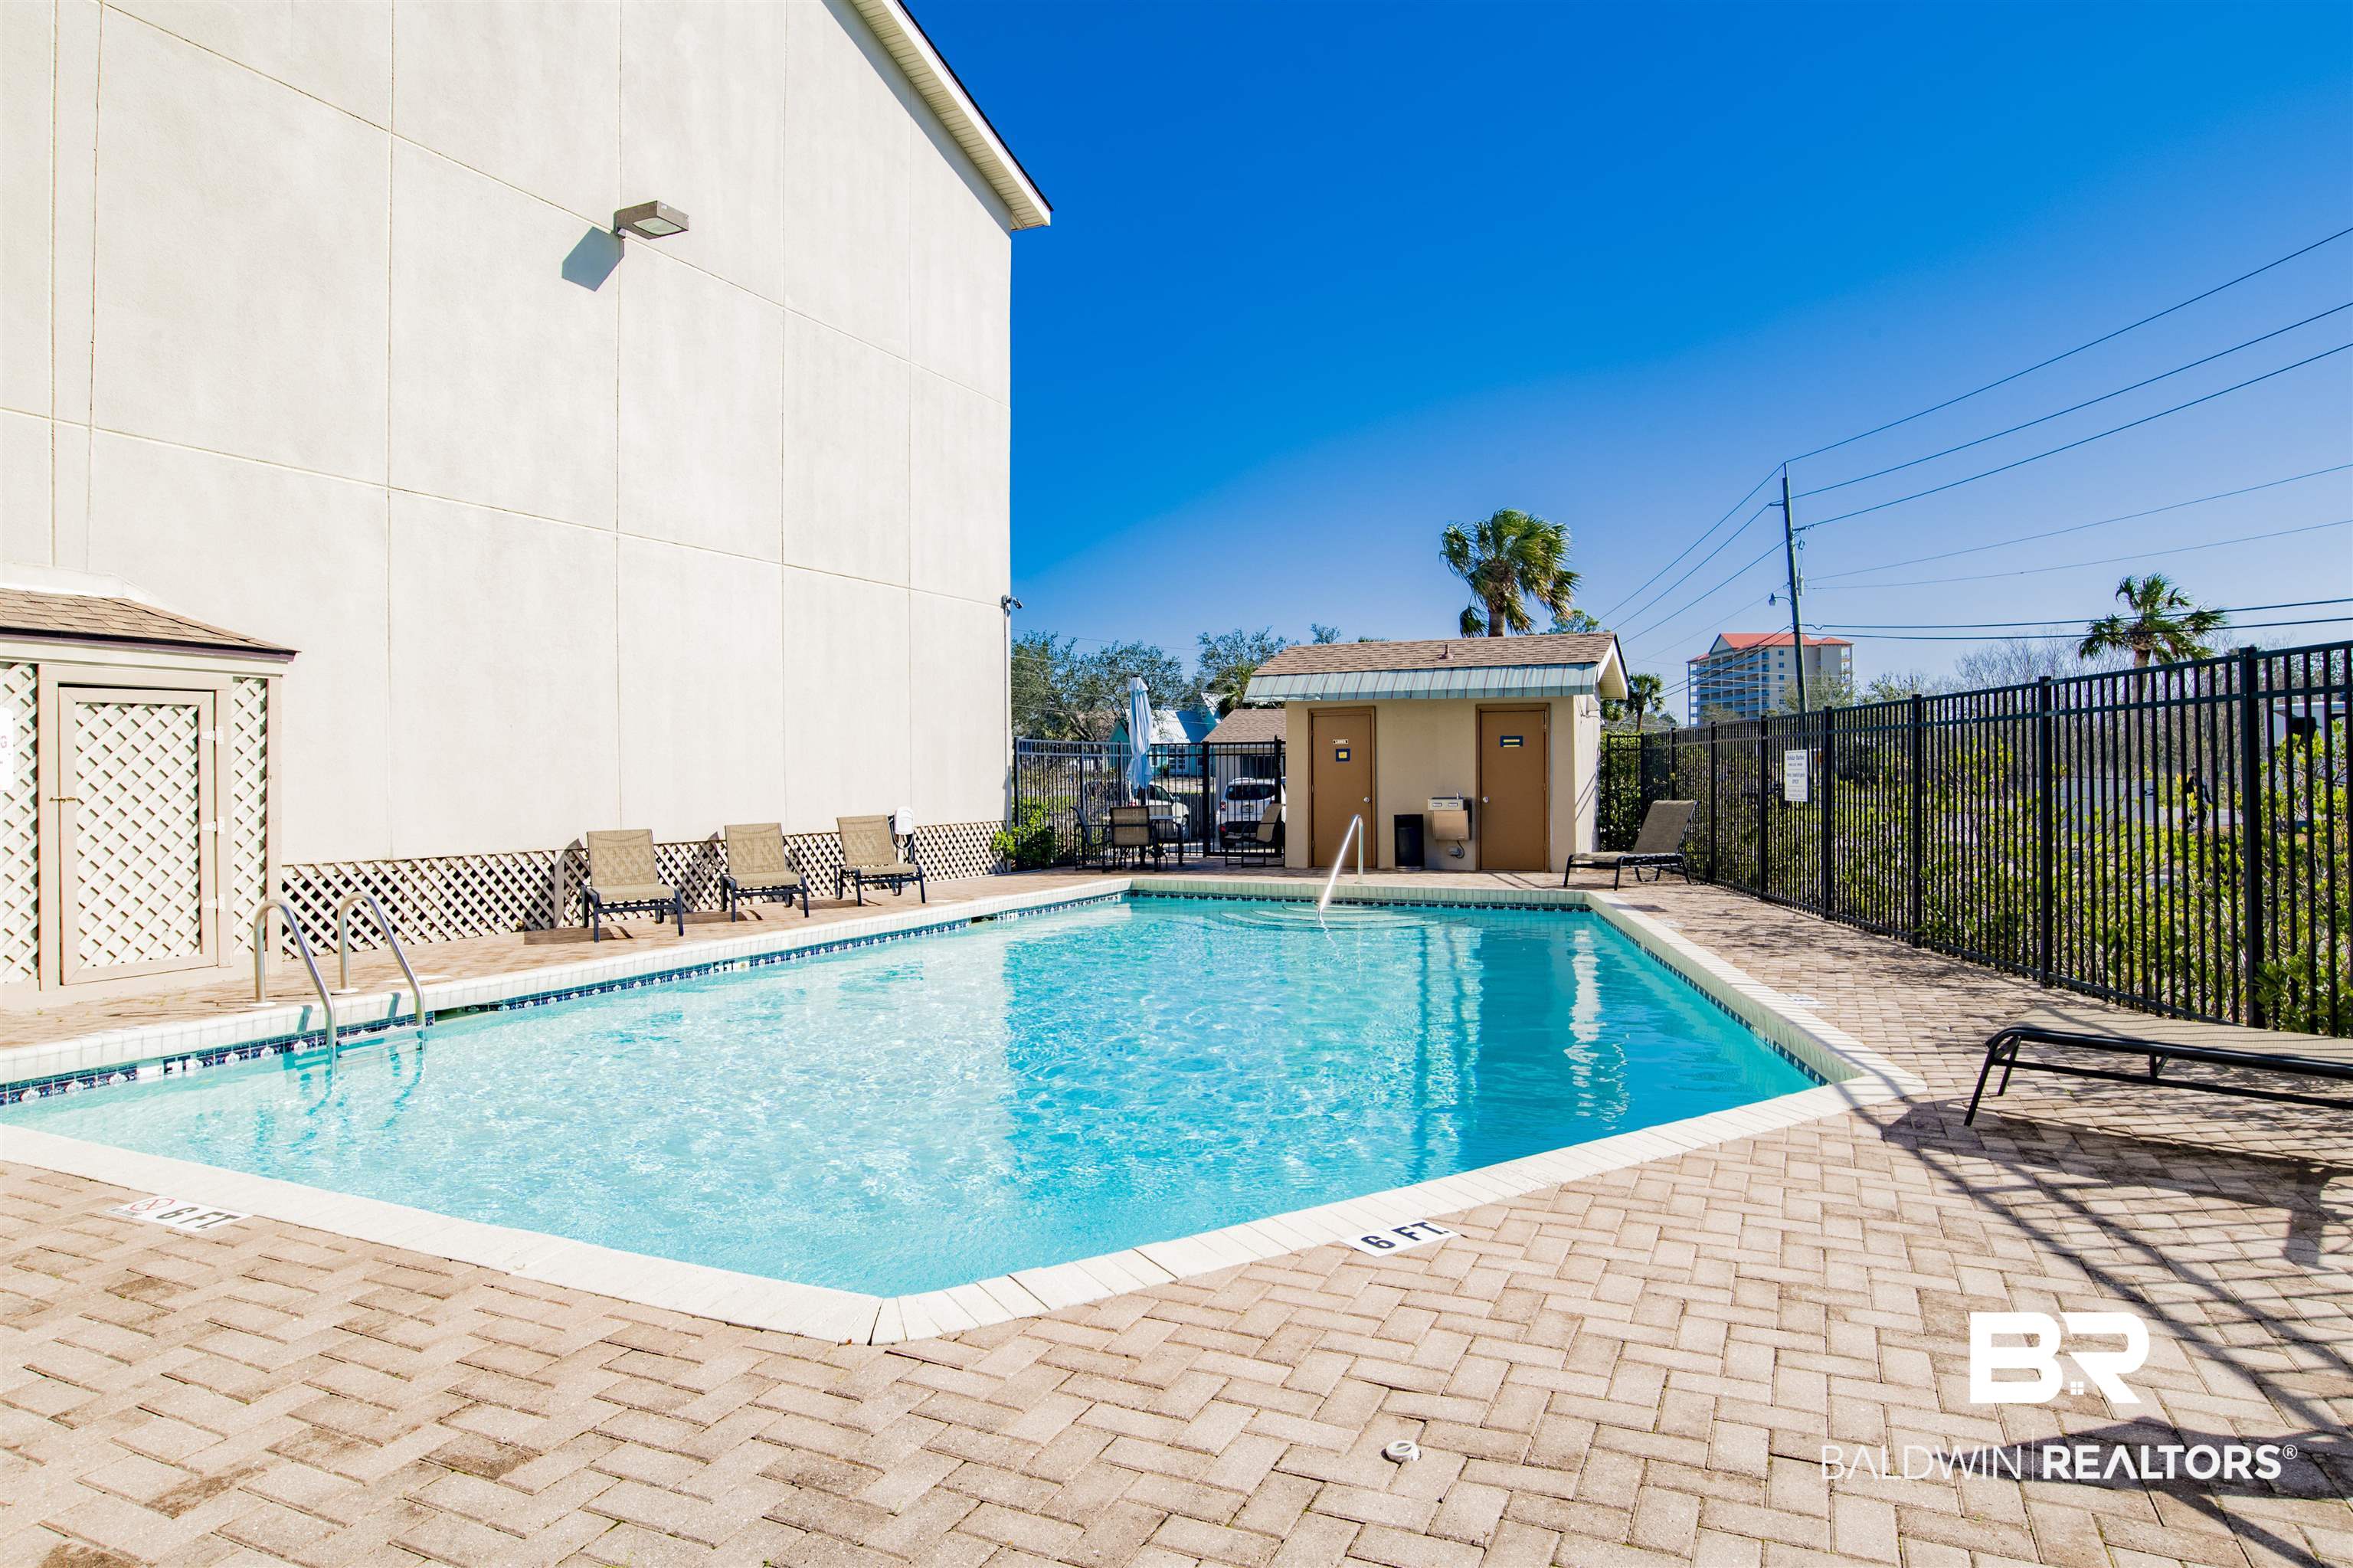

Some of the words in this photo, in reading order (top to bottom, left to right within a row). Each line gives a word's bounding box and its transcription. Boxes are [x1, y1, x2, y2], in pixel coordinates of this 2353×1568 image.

[155, 1206, 197, 1219] 6
[1360, 1235, 1396, 1249] 6
[1391, 1221, 1450, 1242] FT.
